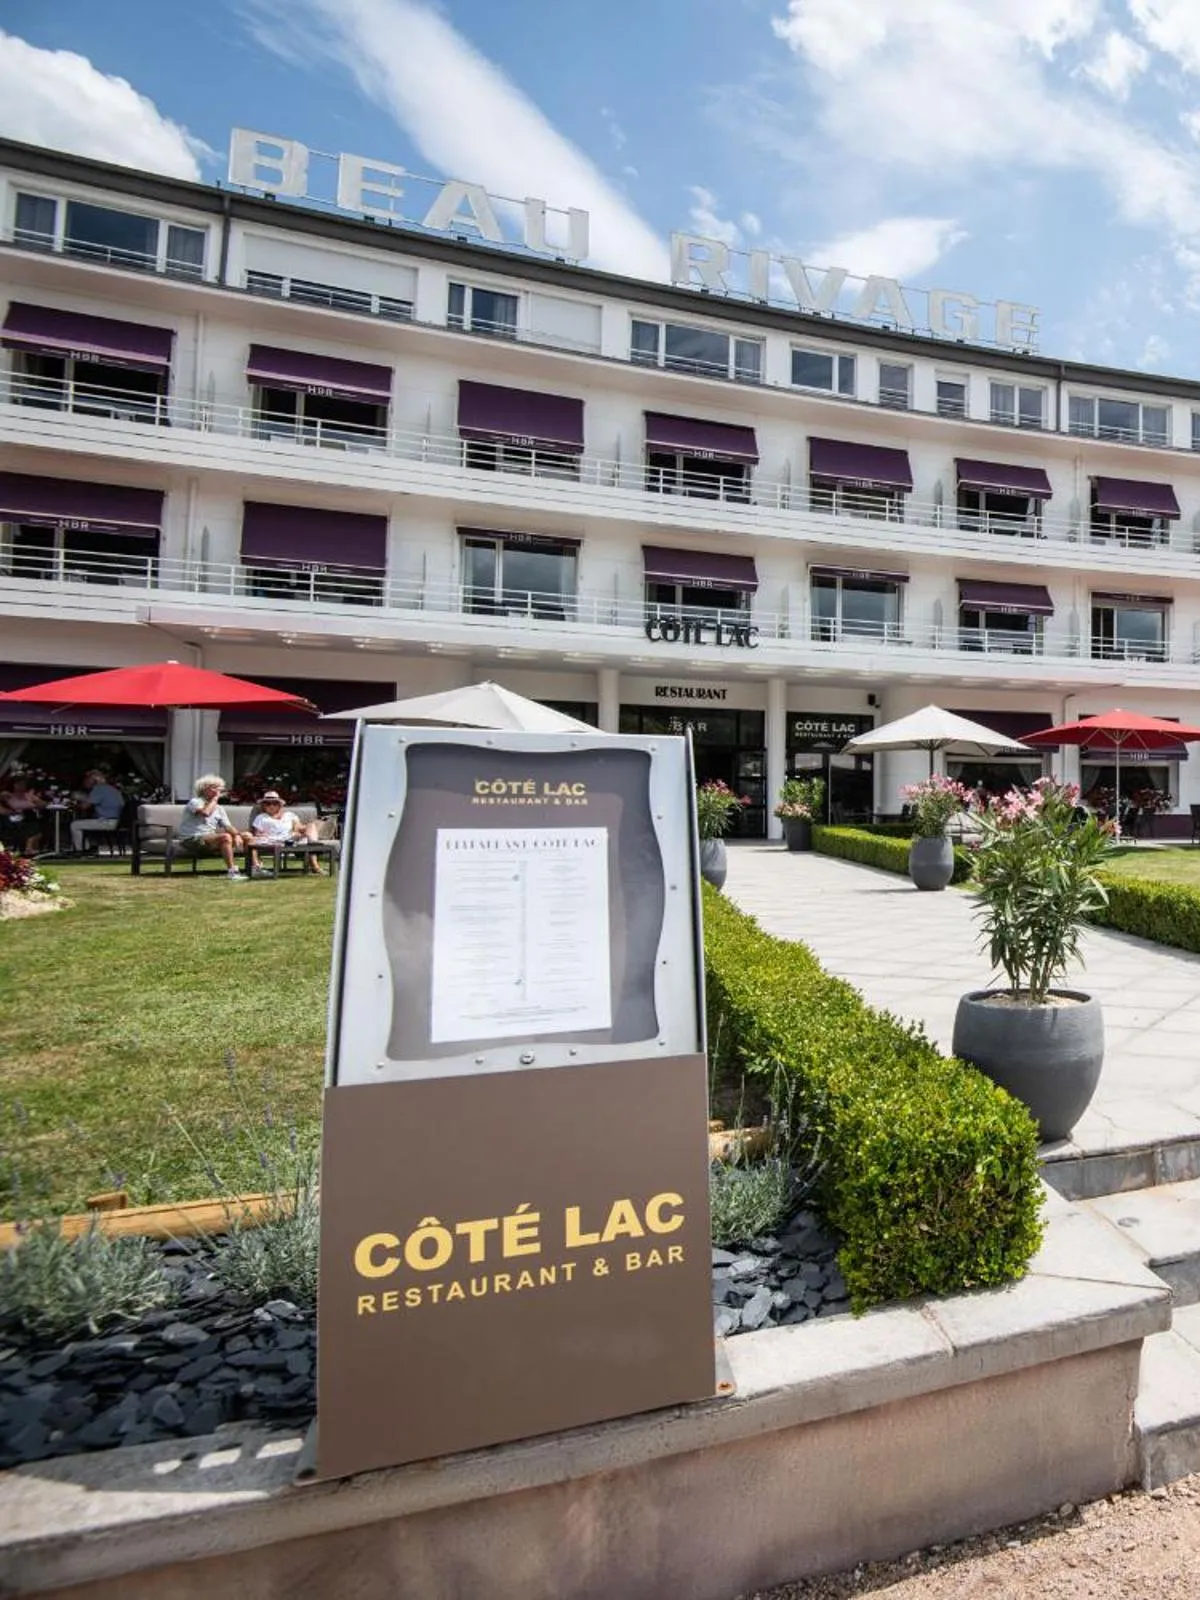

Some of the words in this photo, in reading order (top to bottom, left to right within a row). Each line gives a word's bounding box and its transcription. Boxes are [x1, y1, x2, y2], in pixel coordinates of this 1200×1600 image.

[228, 128, 589, 260] BEAU
[670, 231, 1039, 352] RIVAGE
[71, 351, 101, 362] HBR
[308, 385, 333, 397] HBR
[59, 519, 89, 530] HBR
[692, 580, 714, 589] HBR
[716, 623, 759, 649] LAC
[655, 685, 728, 700] RESTAURANT
[50, 725, 88, 736] HBR
[673, 721, 708, 732] BAR
[291, 735, 325, 745] HBR
[475, 778, 536, 795] CÔTÉ
[544, 781, 586, 796] LAC
[472, 797, 549, 806] RESTAURANT
[354, 1203, 541, 1278] CÔTÉ
[566, 1192, 686, 1248] LAC
[357, 1263, 577, 1315] RESTAURANT
[593, 1258, 610, 1276] &
[626, 1245, 686, 1271] BAR
